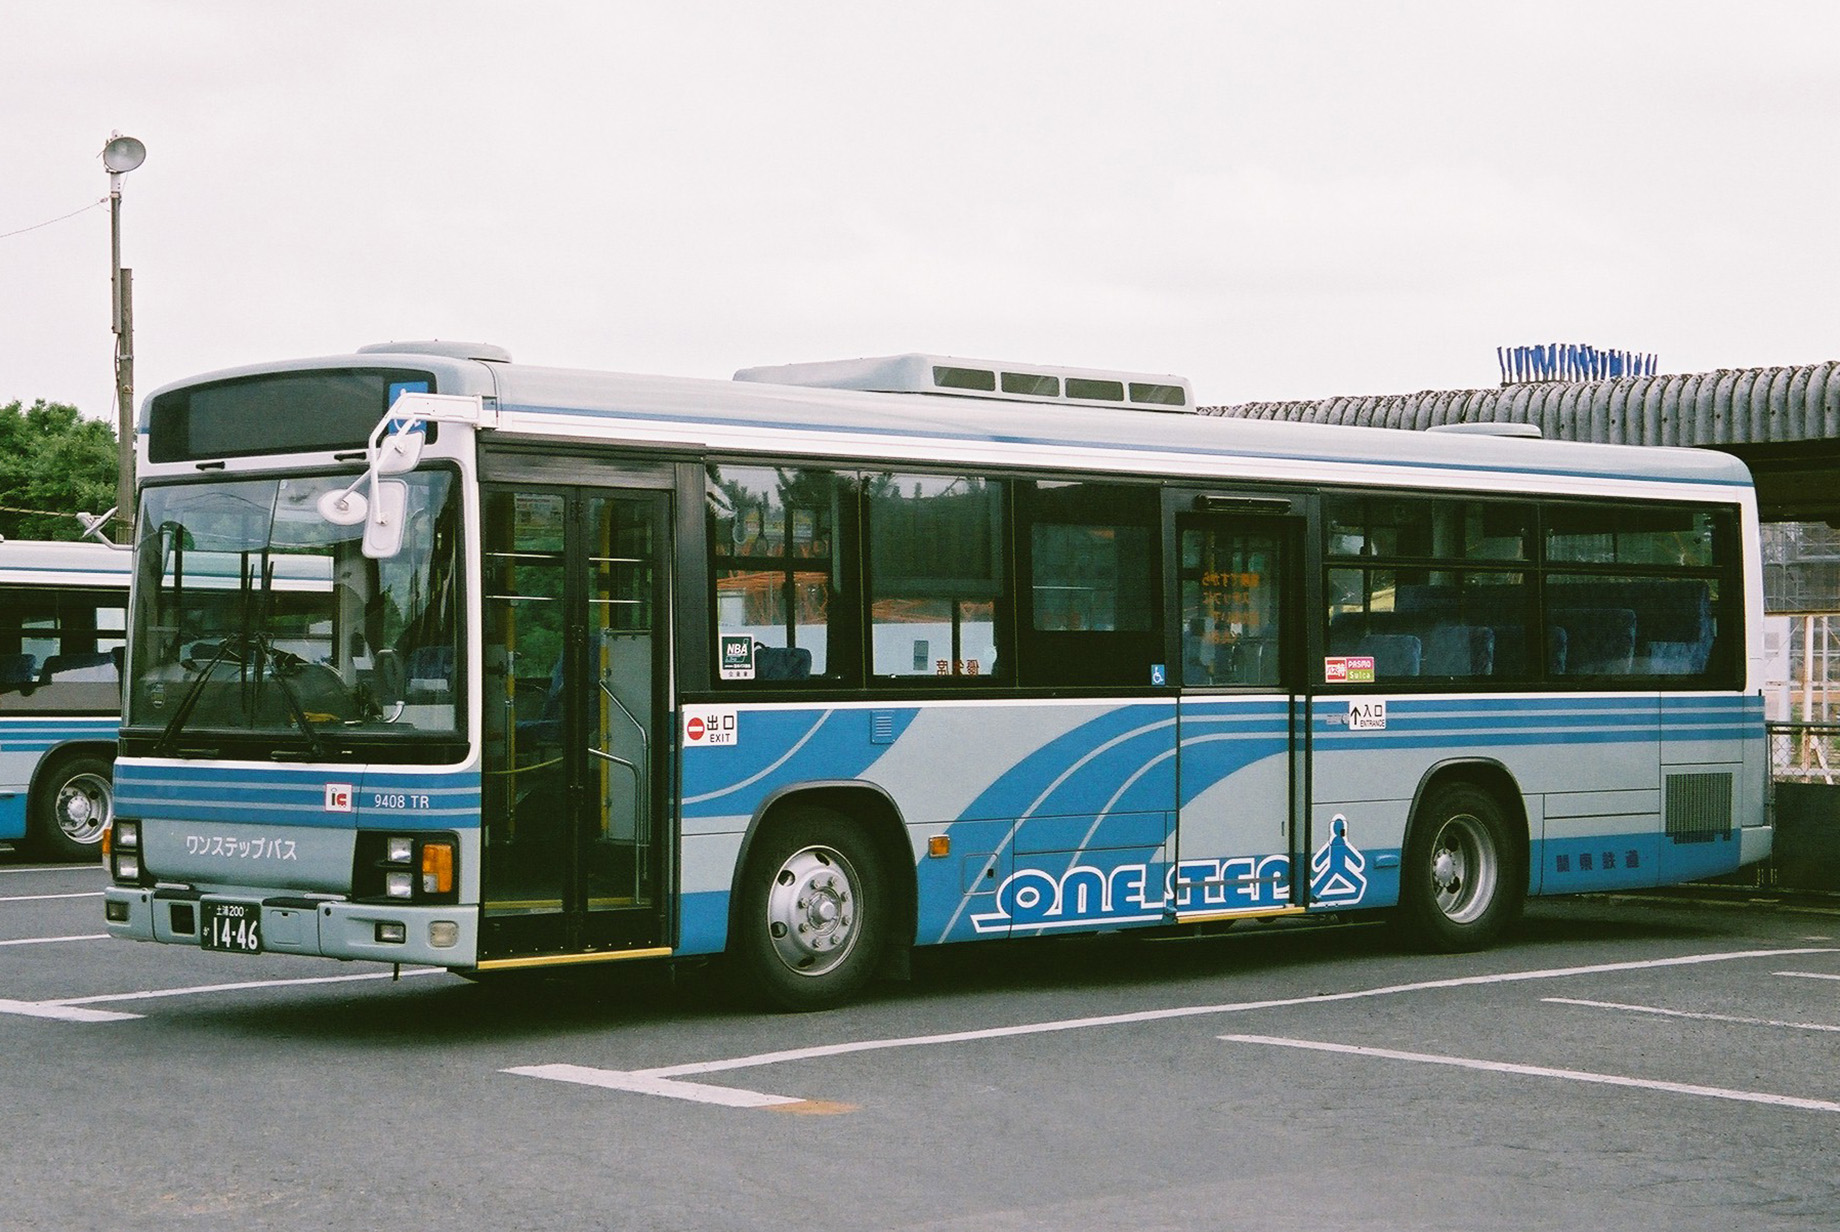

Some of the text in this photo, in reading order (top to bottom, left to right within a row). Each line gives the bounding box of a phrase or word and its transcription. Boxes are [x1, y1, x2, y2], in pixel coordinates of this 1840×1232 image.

[727, 643, 748, 656] NBA
[1347, 660, 1371, 668] PASMO
[1349, 671, 1371, 680] Suica
[1363, 704, 1383, 718] 入口
[707, 715, 735, 731] 出口
[1360, 719, 1385, 728] ENTRANCE
[710, 733, 731, 743] EXIT
[374, 794, 430, 809] 9408 TR
[186, 835, 298, 861] ワンステップバス
[995, 864, 1163, 920] ONE
